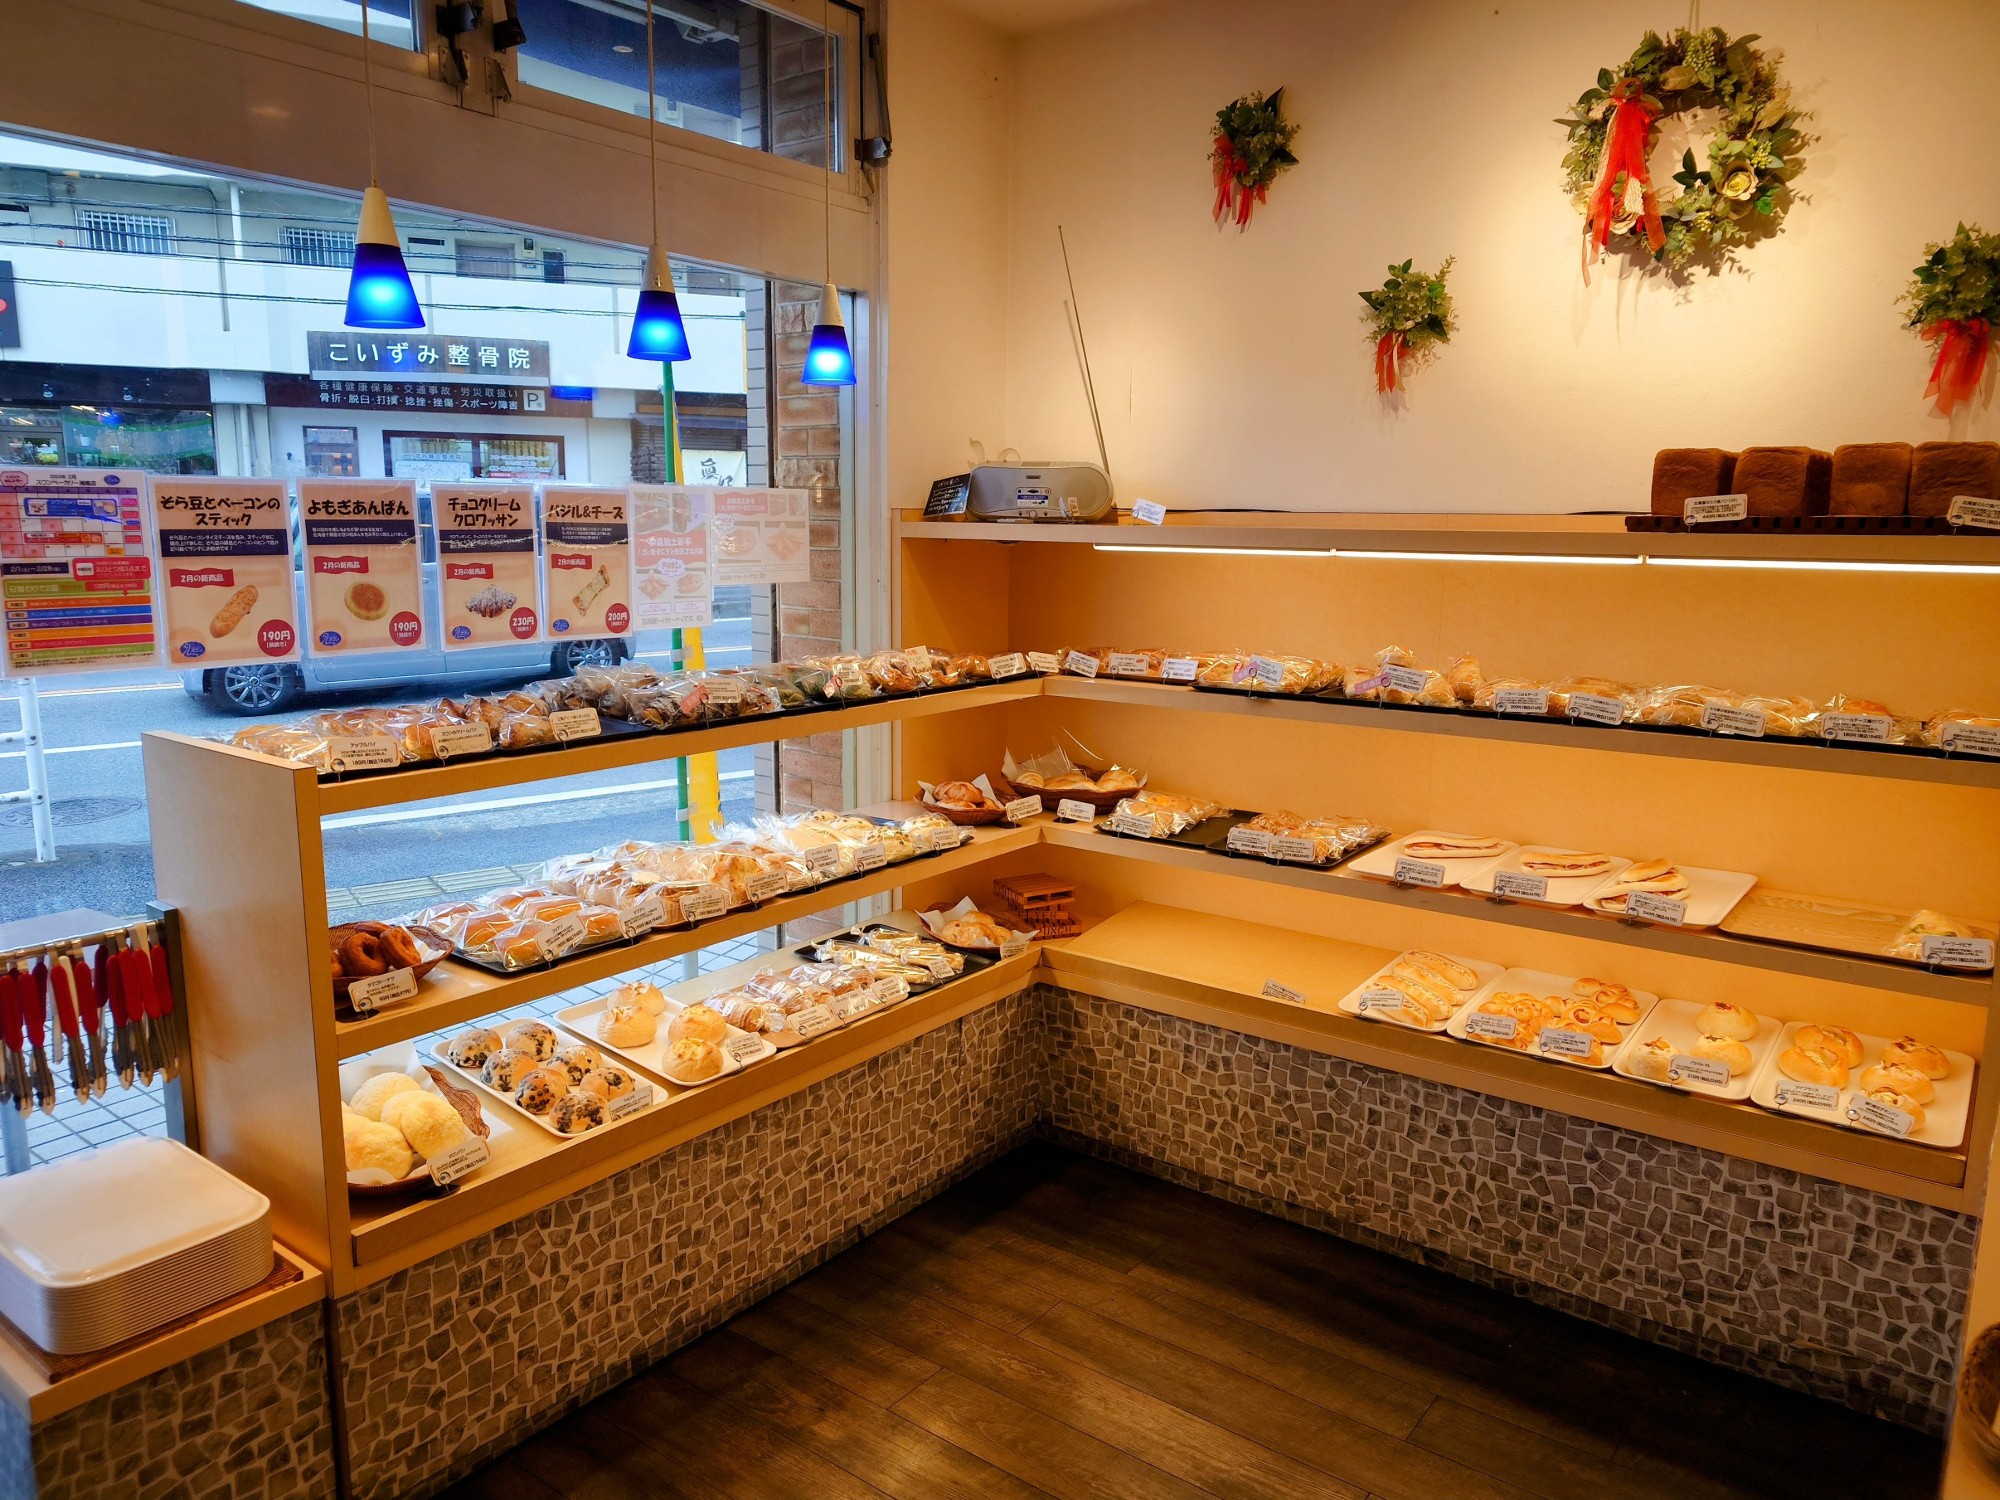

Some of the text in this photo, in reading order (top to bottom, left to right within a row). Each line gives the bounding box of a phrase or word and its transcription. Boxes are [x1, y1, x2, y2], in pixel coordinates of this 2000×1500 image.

[329, 342, 531, 369] こいずみ整骨院
[527, 392, 539, 407] P
[160, 496, 281, 510] そら豆とベーコンの
[308, 499, 410, 516] よもぎあんぱん
[448, 497, 522, 512] チョコクリーム
[548, 504, 624, 520] バジル&チーズ
[195, 513, 252, 526] スティック
[453, 513, 519, 527] クロワッサン
[323, 561, 361, 570] 2月の新商品
[453, 568, 487, 576] 2月の新商品
[180, 574, 224, 583] 2月の新商品
[512, 616, 535, 626] 230円
[608, 612, 627, 621] 200円
[393, 622, 418, 632] 190円
[261, 631, 291, 642] 190円
[448, 1148, 466, 1160] メロンパン
